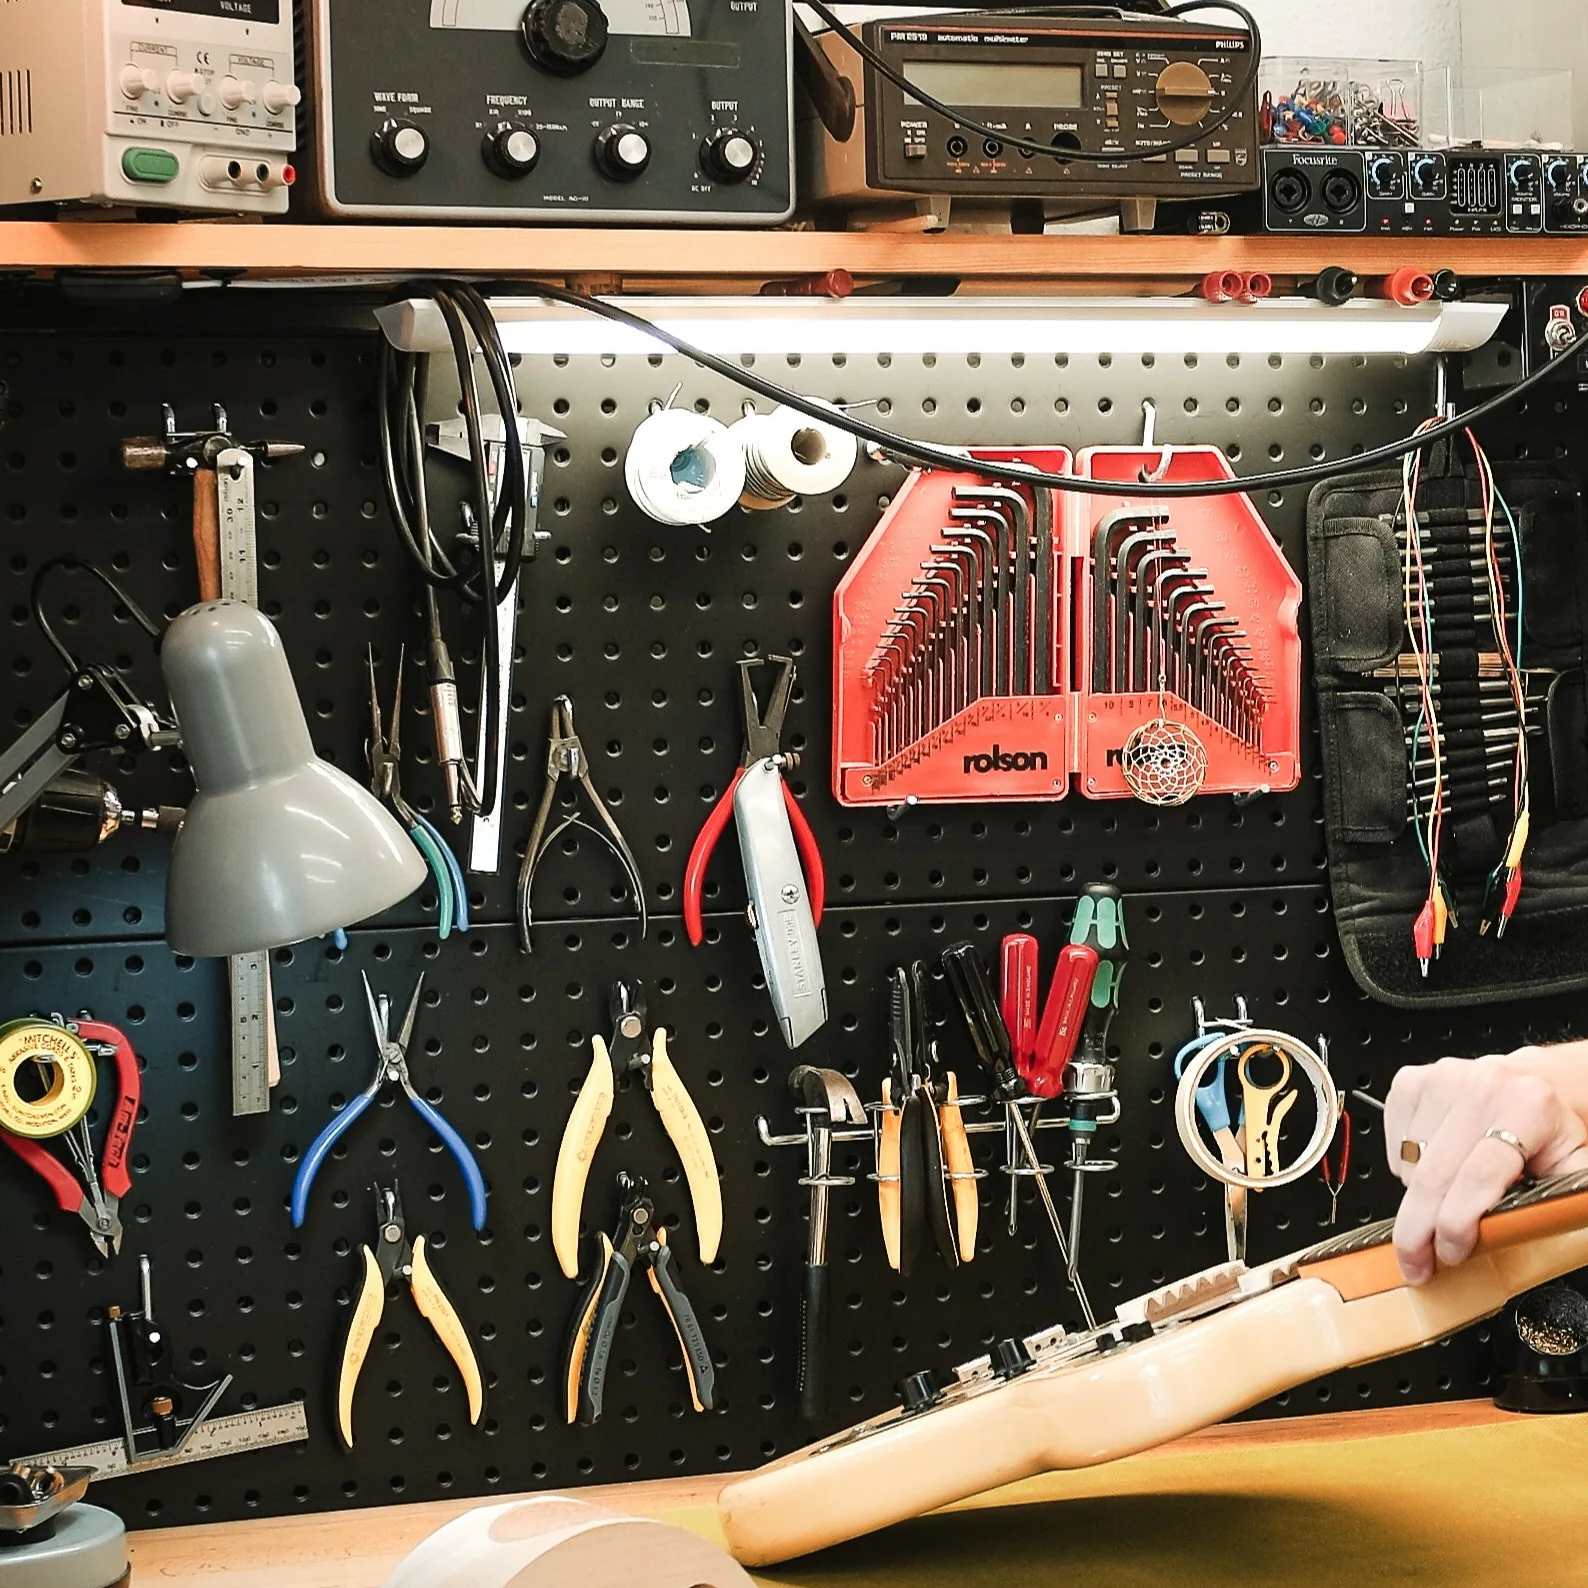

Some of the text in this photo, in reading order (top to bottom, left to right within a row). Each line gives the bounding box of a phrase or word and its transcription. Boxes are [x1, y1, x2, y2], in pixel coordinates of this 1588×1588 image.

[220, 1, 252, 14] VOLTAGE
[730, 1, 757, 12] OUTPUT
[937, 34, 979, 42] automatic
[984, 35, 1029, 43] multimeter
[1215, 40, 1245, 49] PHILIPS
[373, 91, 419, 103] WAVE FORM
[486, 94, 528, 107] FREQUENCY
[589, 98, 645, 109] OUTPUT RANGE
[711, 101, 739, 111] OUTPUT
[1292, 154, 1338, 166] Focusrite
[236, 498, 244, 512] 12
[226, 508, 234, 523] 30
[238, 549, 246, 564] 11
[1104, 701, 1115, 710] 10
[963, 744, 1048, 774] rolson
[787, 939, 807, 993] STANLEY
